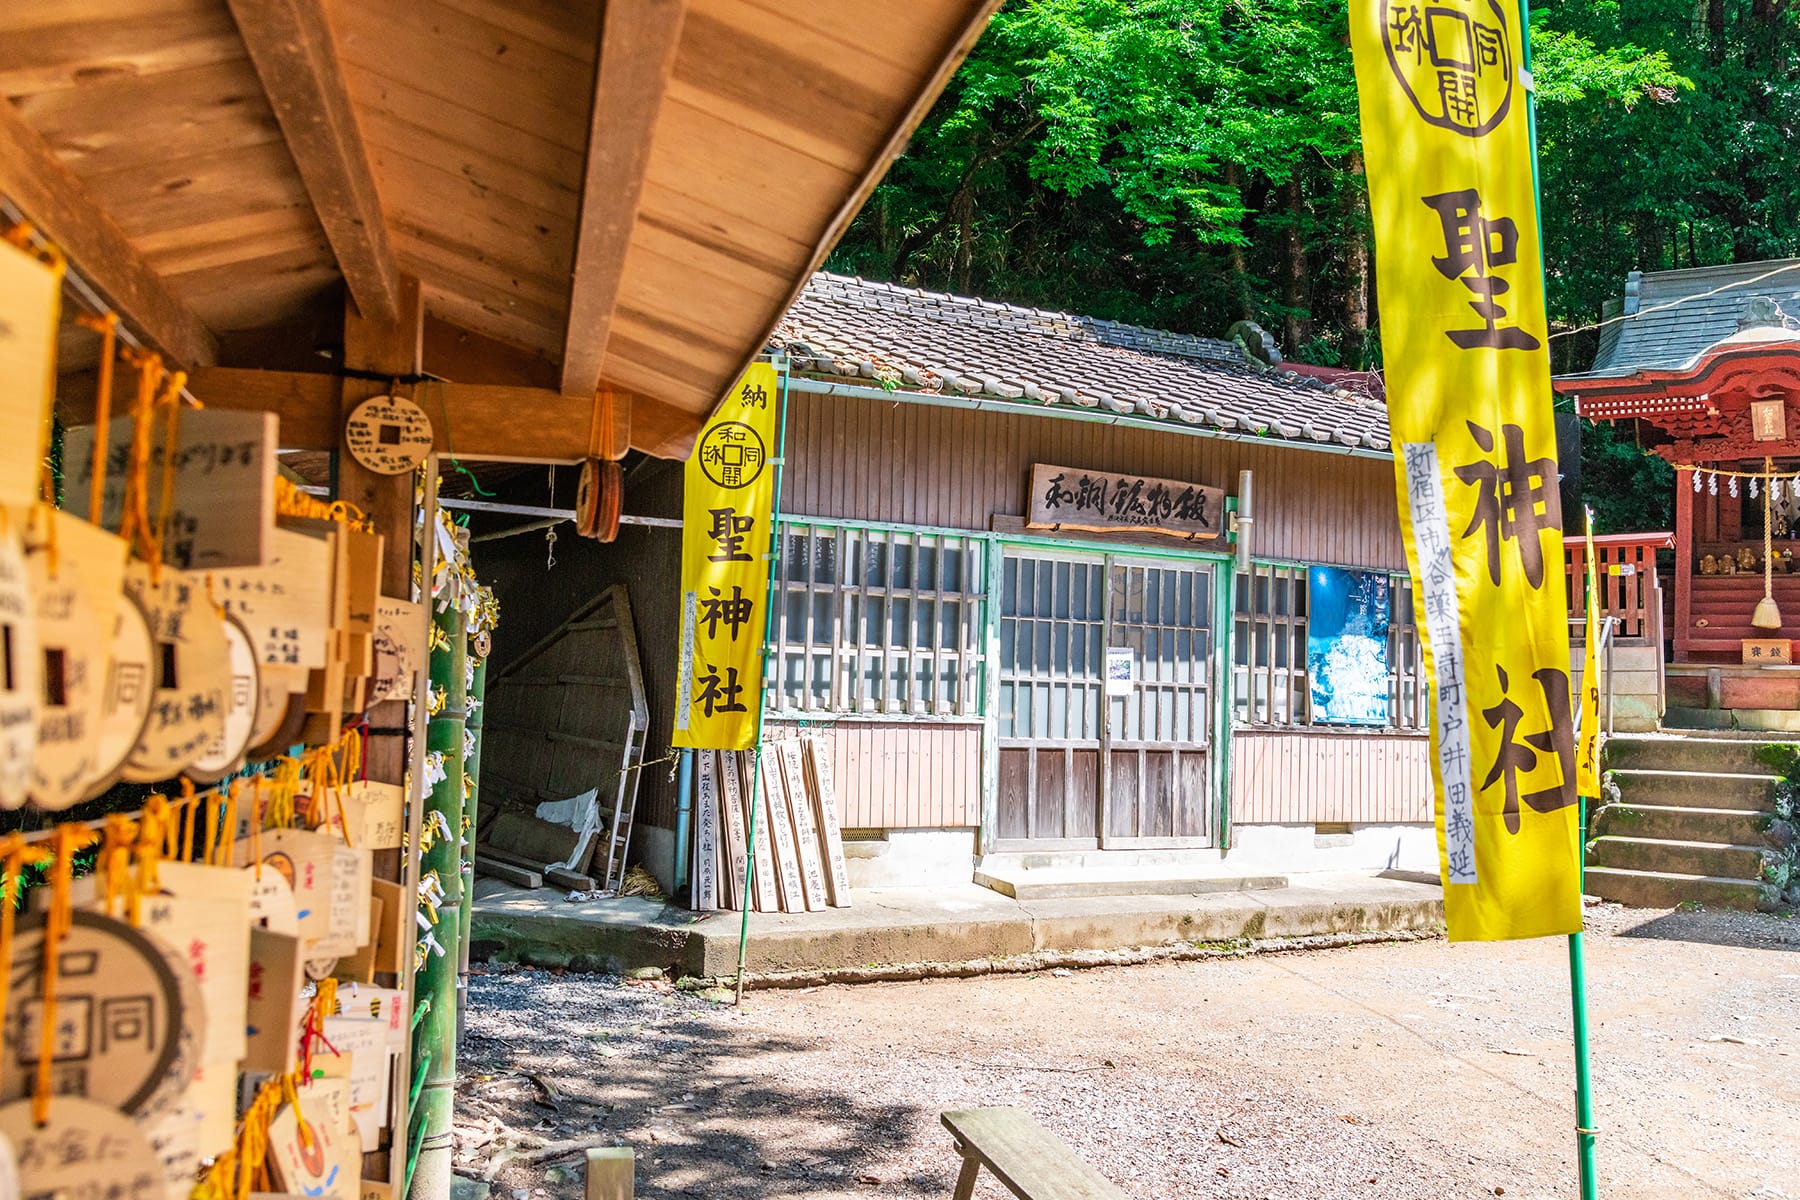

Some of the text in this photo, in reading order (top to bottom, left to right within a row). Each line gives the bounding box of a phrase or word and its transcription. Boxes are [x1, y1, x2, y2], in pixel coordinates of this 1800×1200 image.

[694, 506, 754, 719] 聖神社
[1422, 188, 1579, 834] 聖神社
